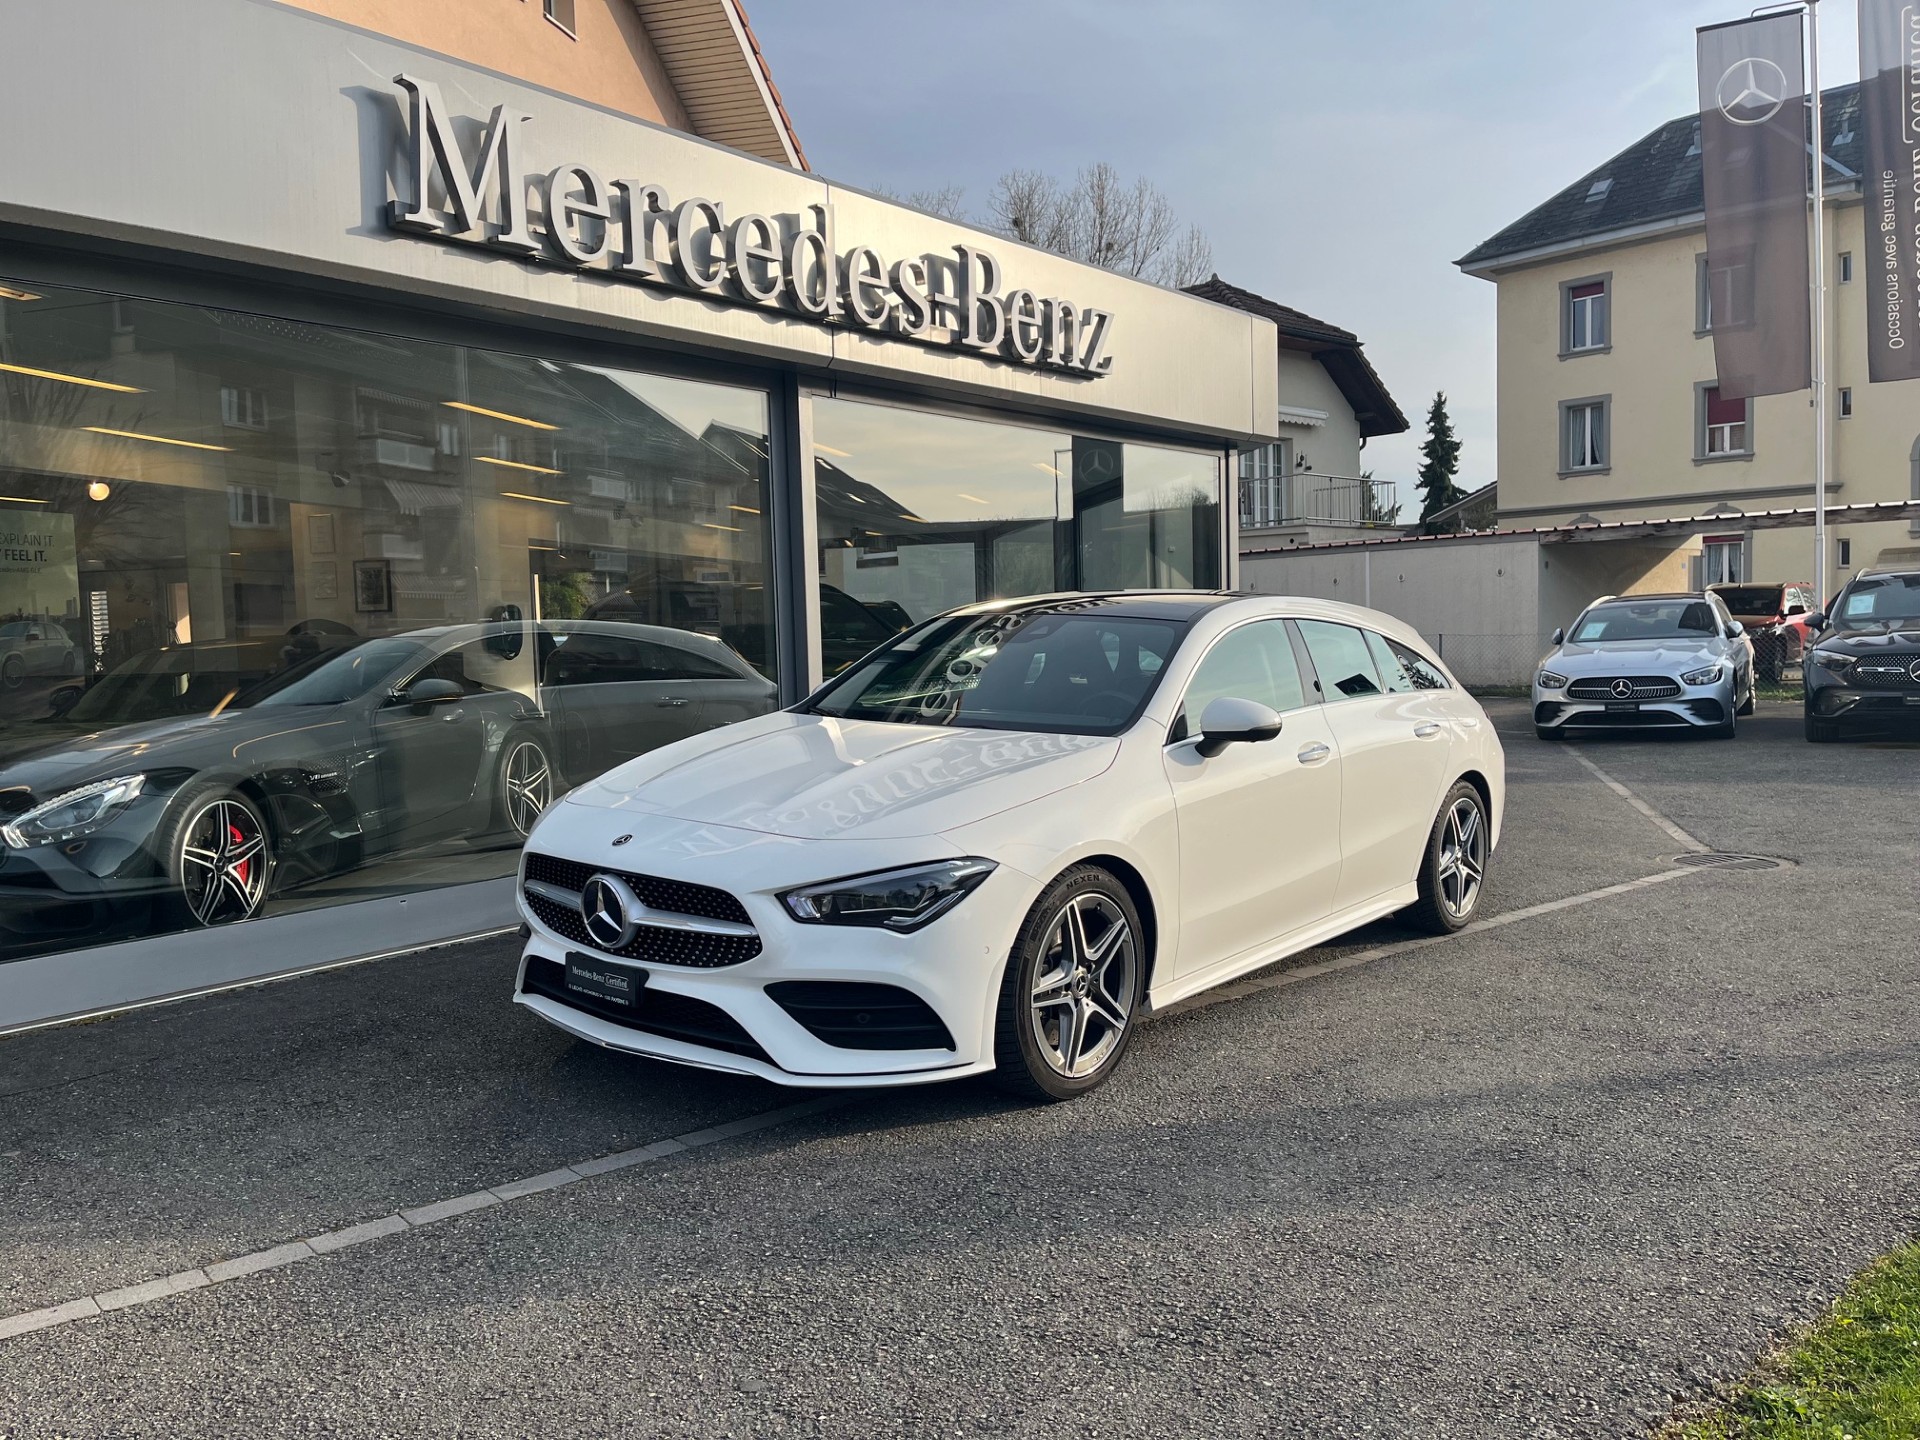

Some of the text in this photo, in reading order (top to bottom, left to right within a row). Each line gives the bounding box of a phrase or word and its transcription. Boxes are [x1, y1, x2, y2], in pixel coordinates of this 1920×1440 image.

[388, 73, 1114, 378] Mercedes-Benz
[44, 535, 55, 548] IT.
[4, 549, 47, 562] FEEL IT.
[1066, 874, 1100, 890] NEXEN
